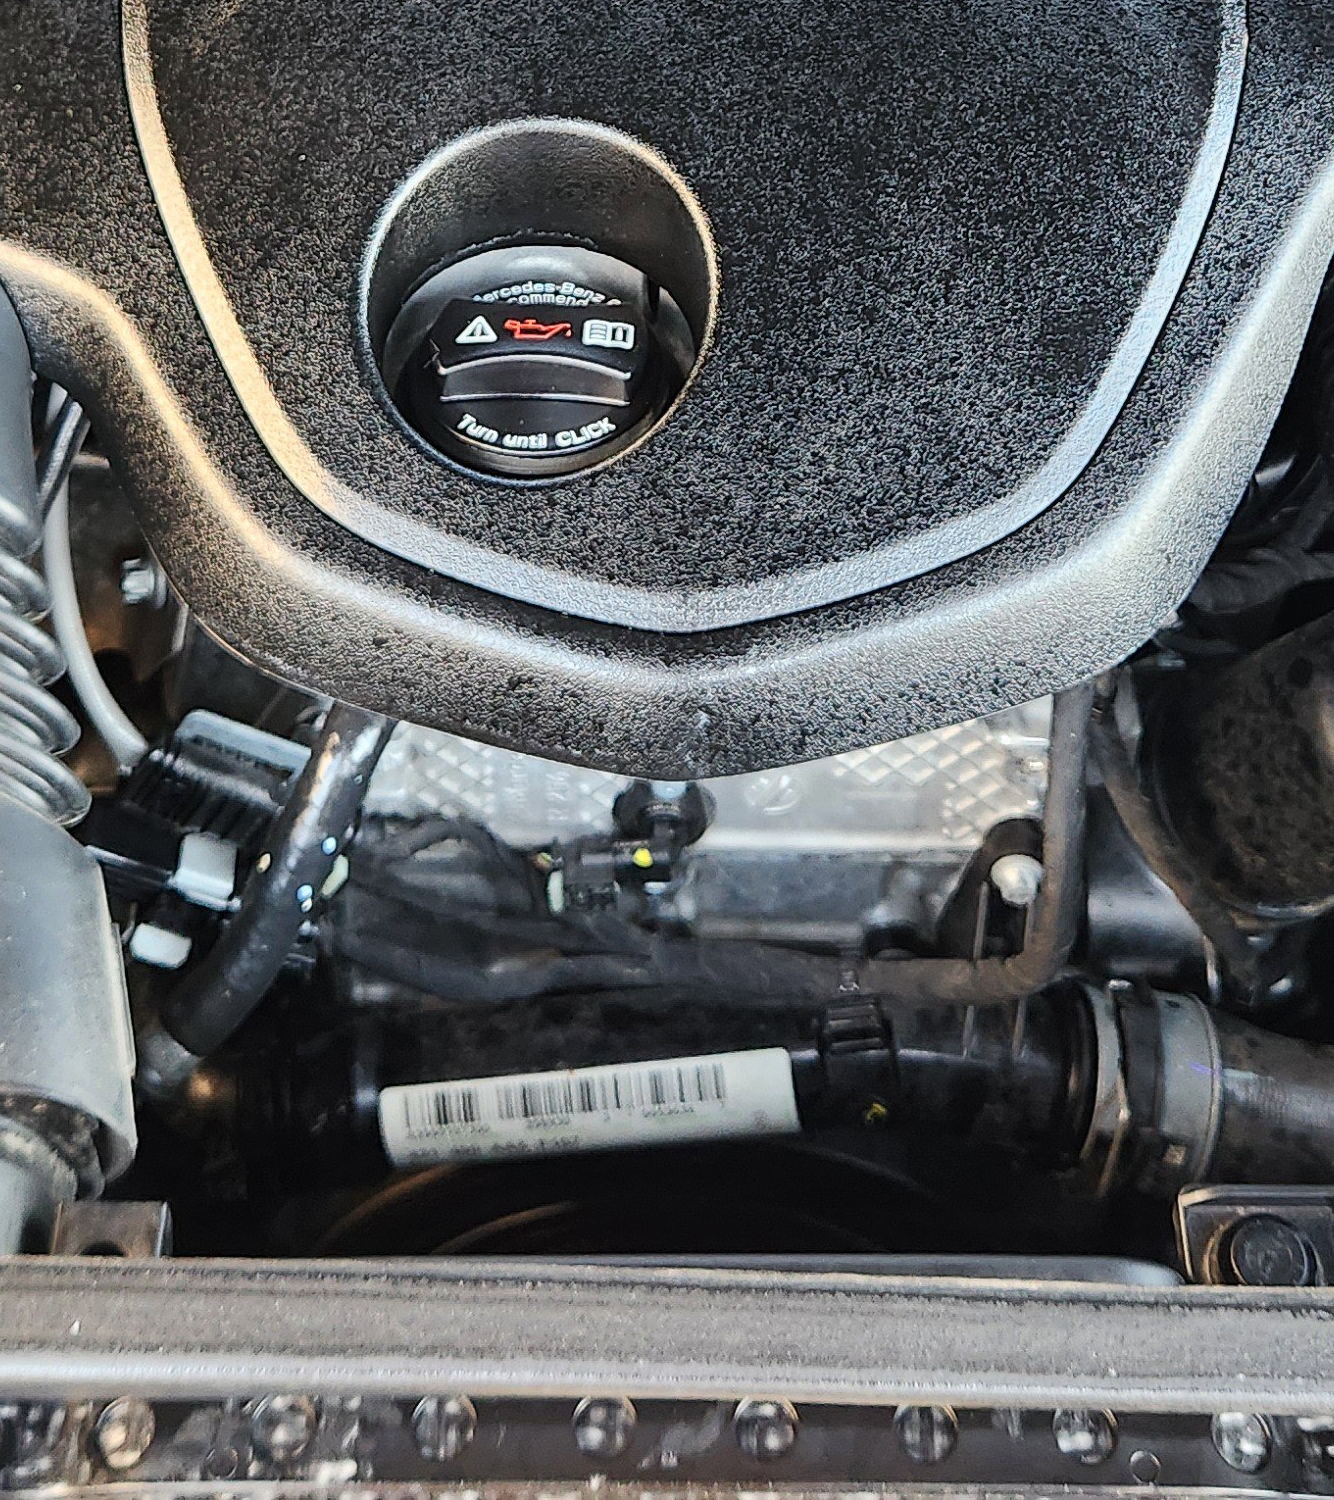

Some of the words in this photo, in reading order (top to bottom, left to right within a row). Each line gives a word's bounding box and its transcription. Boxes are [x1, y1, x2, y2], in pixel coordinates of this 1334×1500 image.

[457, 414, 498, 442] Turn
[502, 433, 548, 449] until
[554, 417, 616, 448] CLICK
